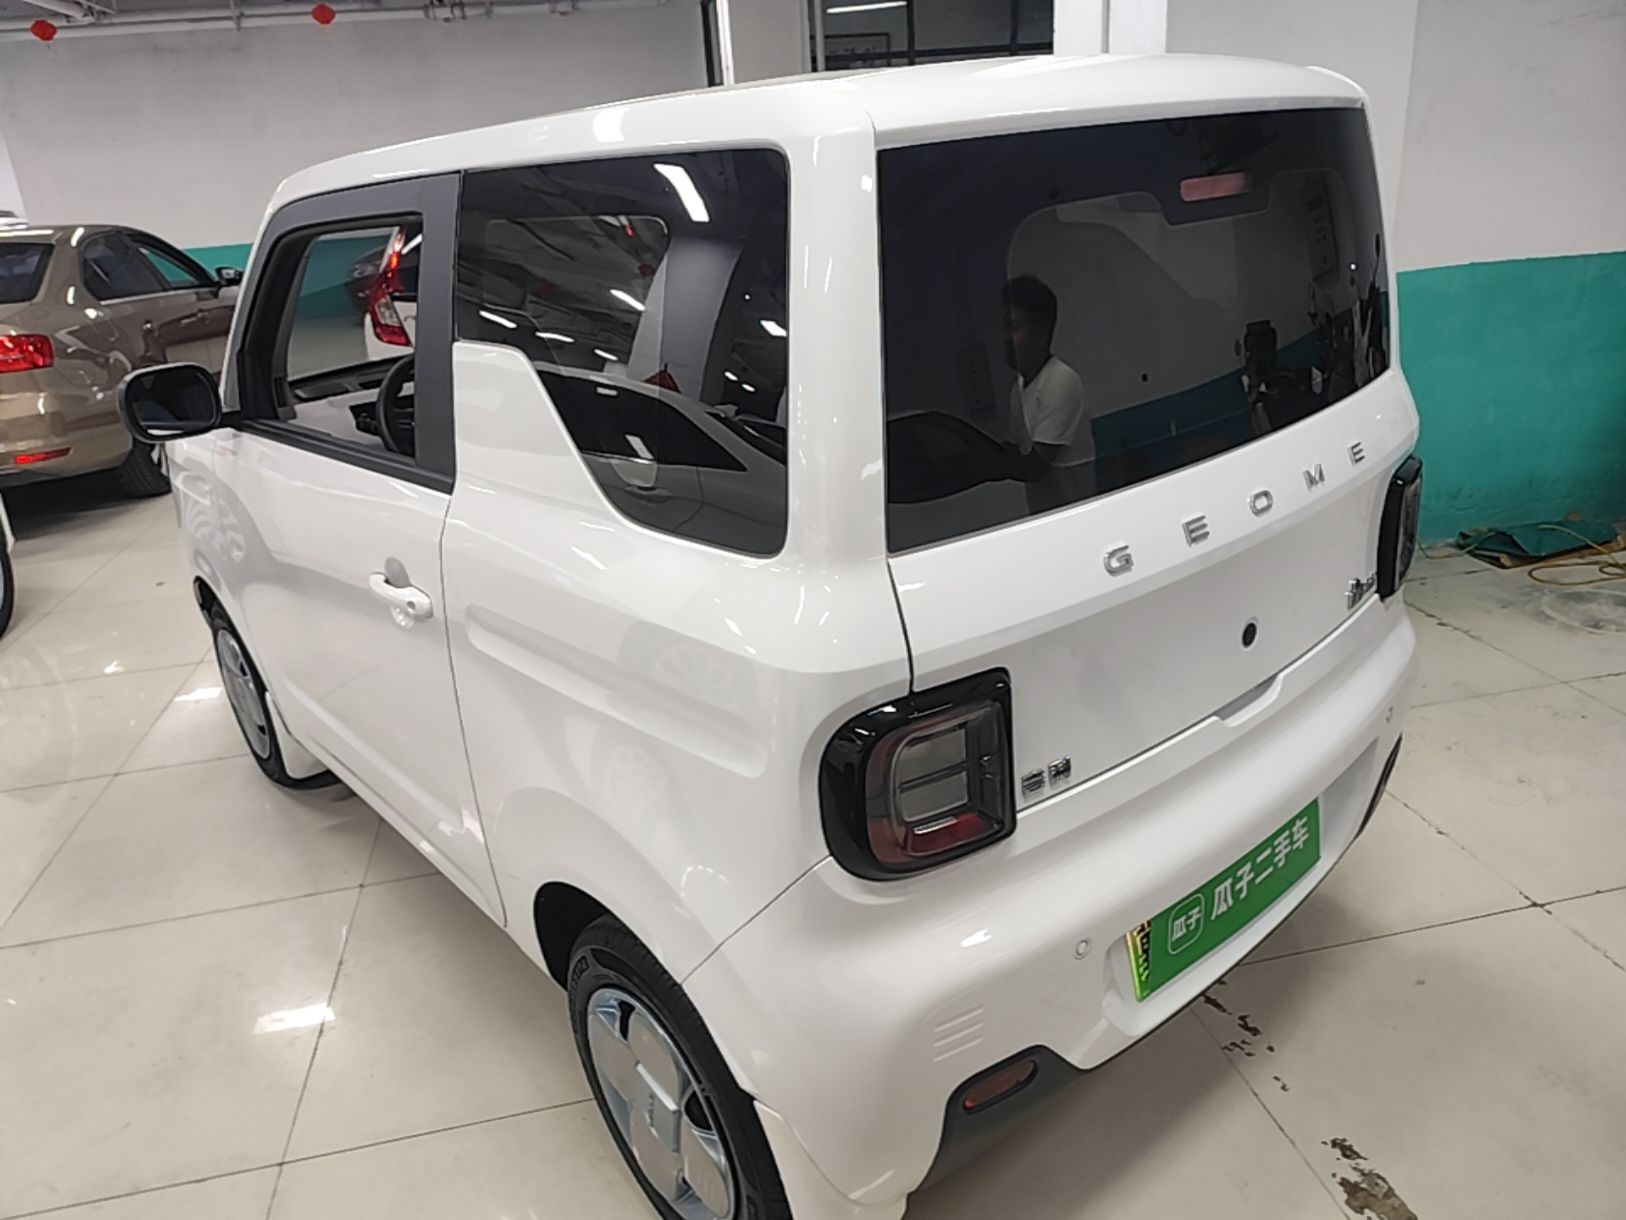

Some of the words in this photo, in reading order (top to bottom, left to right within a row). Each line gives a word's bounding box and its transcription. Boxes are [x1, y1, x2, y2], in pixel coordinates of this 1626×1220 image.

[1104, 441, 1366, 578] GEOME
[1171, 906, 1203, 942] 瓜子
[1210, 816, 1310, 921] 瓜子二手车
